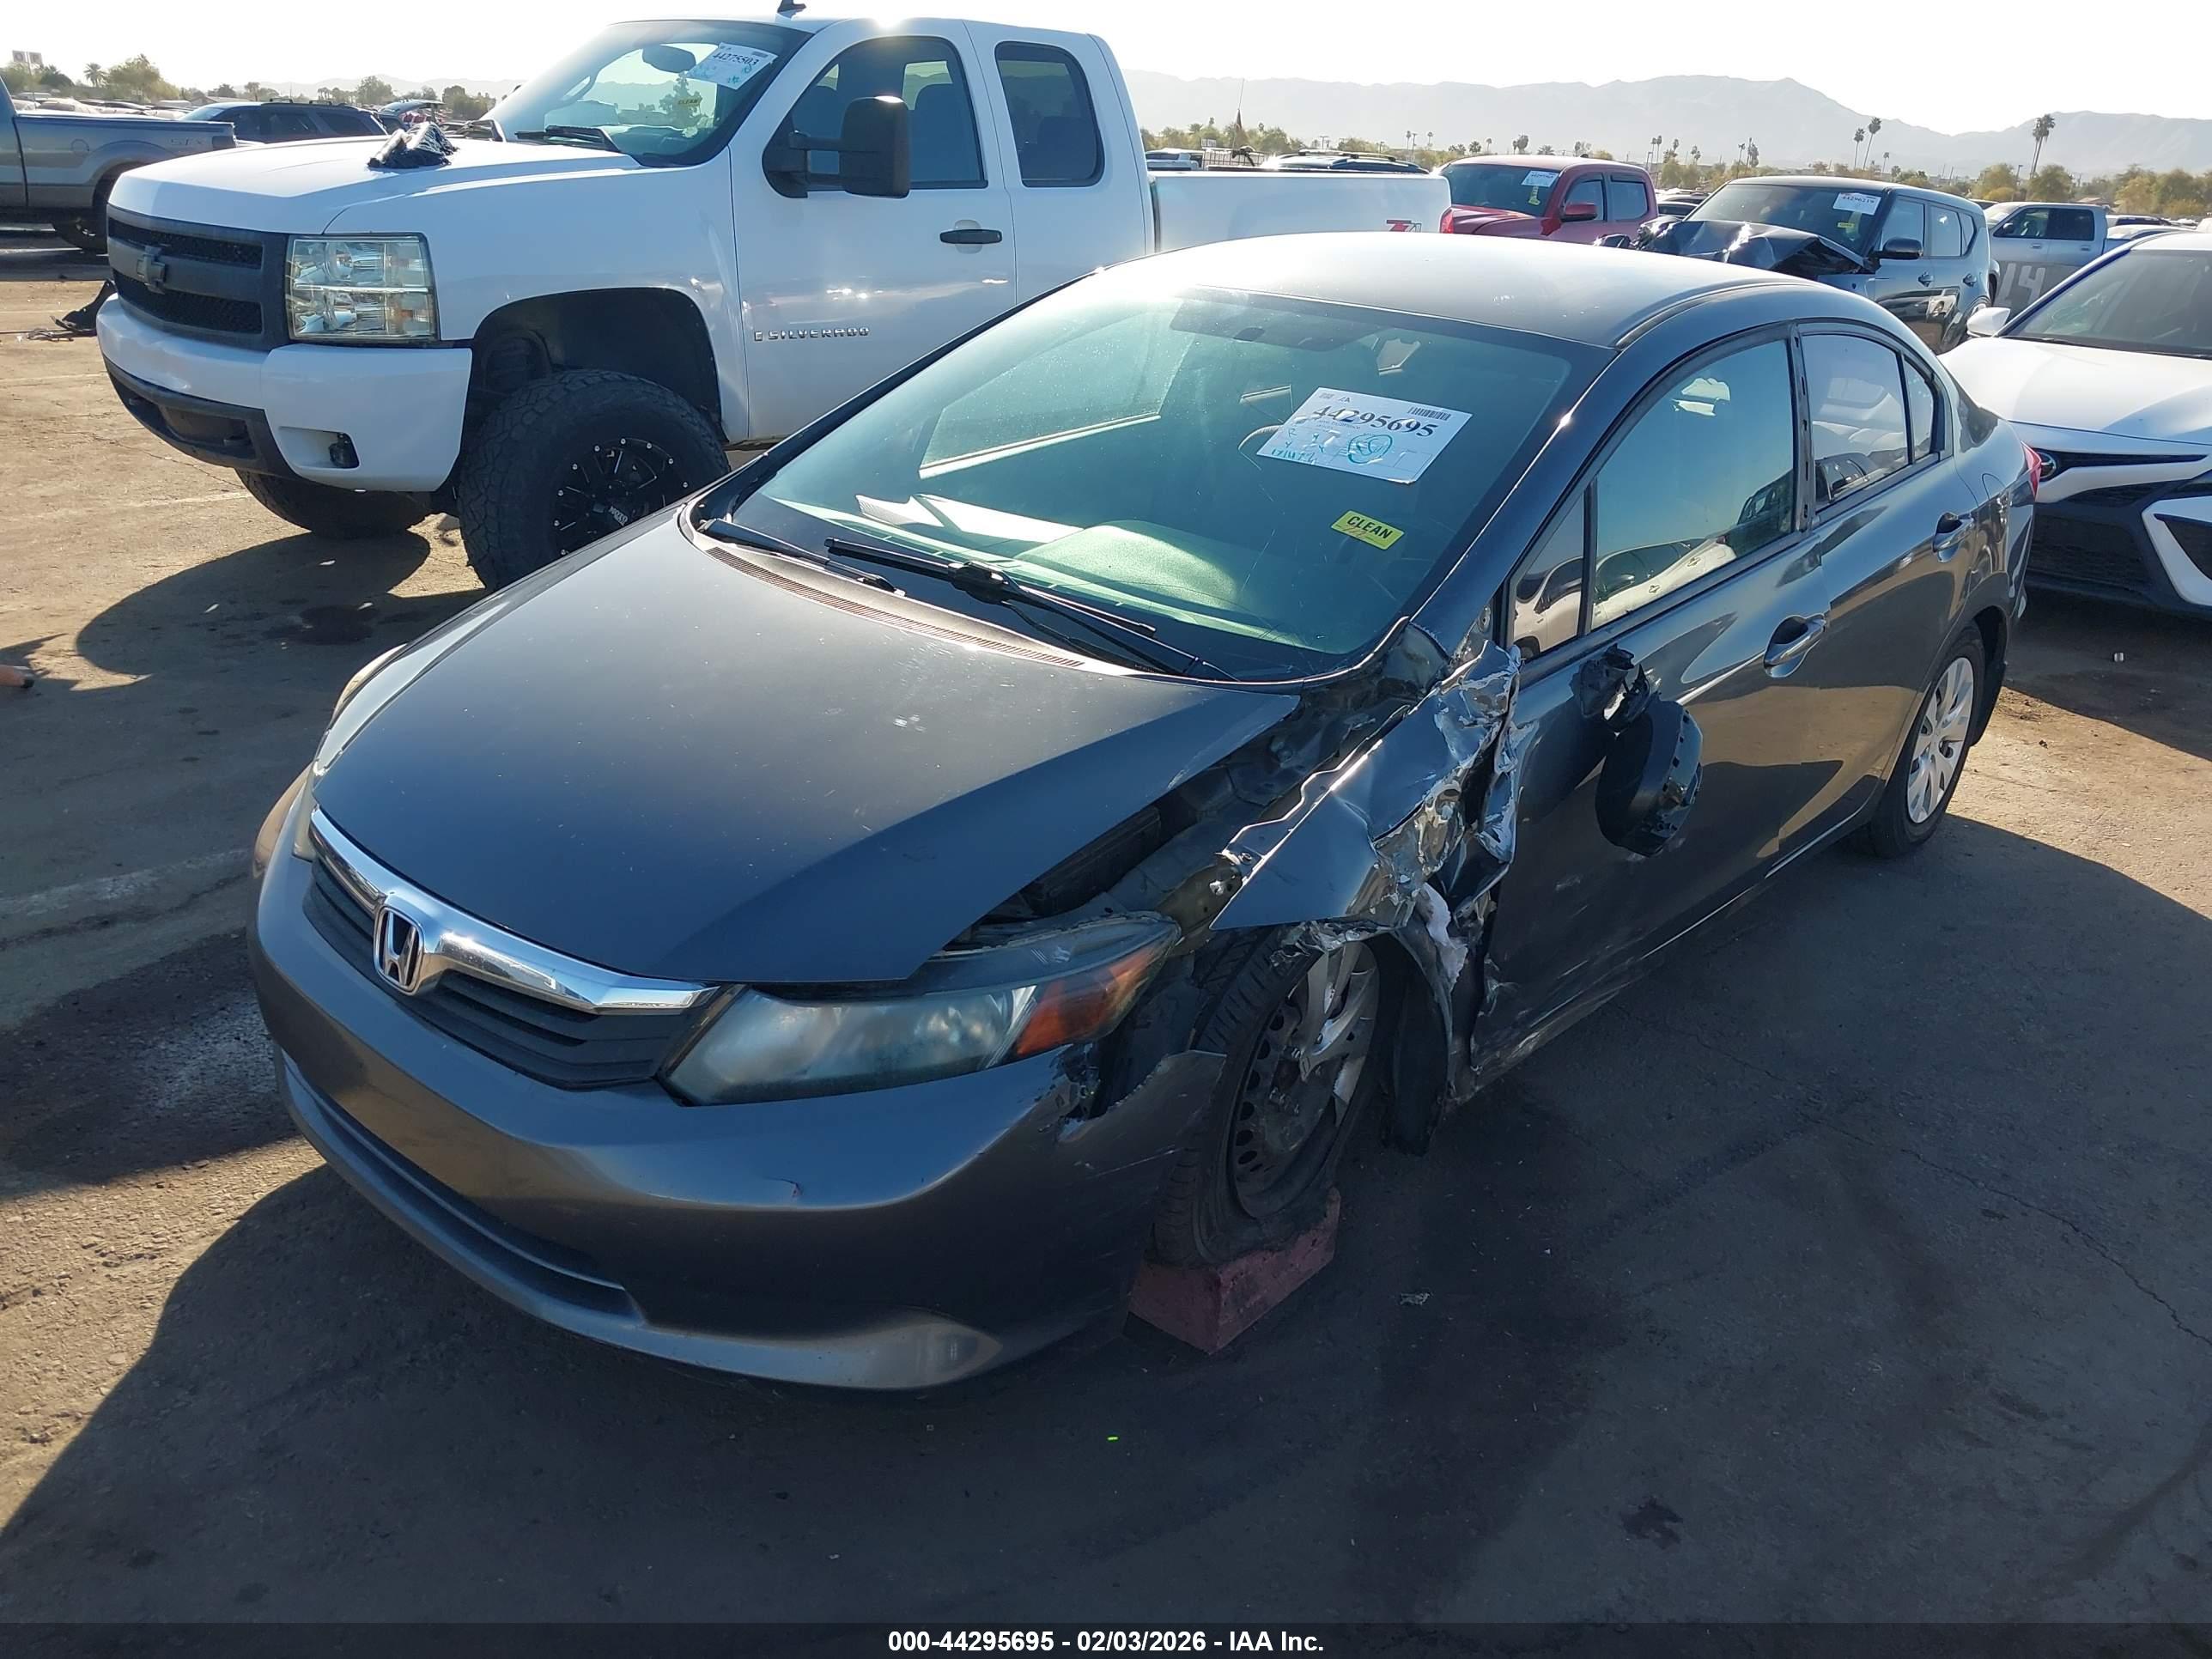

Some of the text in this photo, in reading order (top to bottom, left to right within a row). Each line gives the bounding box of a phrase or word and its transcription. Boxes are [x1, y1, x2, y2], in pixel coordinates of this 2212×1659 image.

[712, 52, 760, 65] 44275503
[768, 326, 870, 340] SILVERADO
[1312, 404, 1438, 438] 44295695
[1346, 515, 1393, 539] CLEAN
